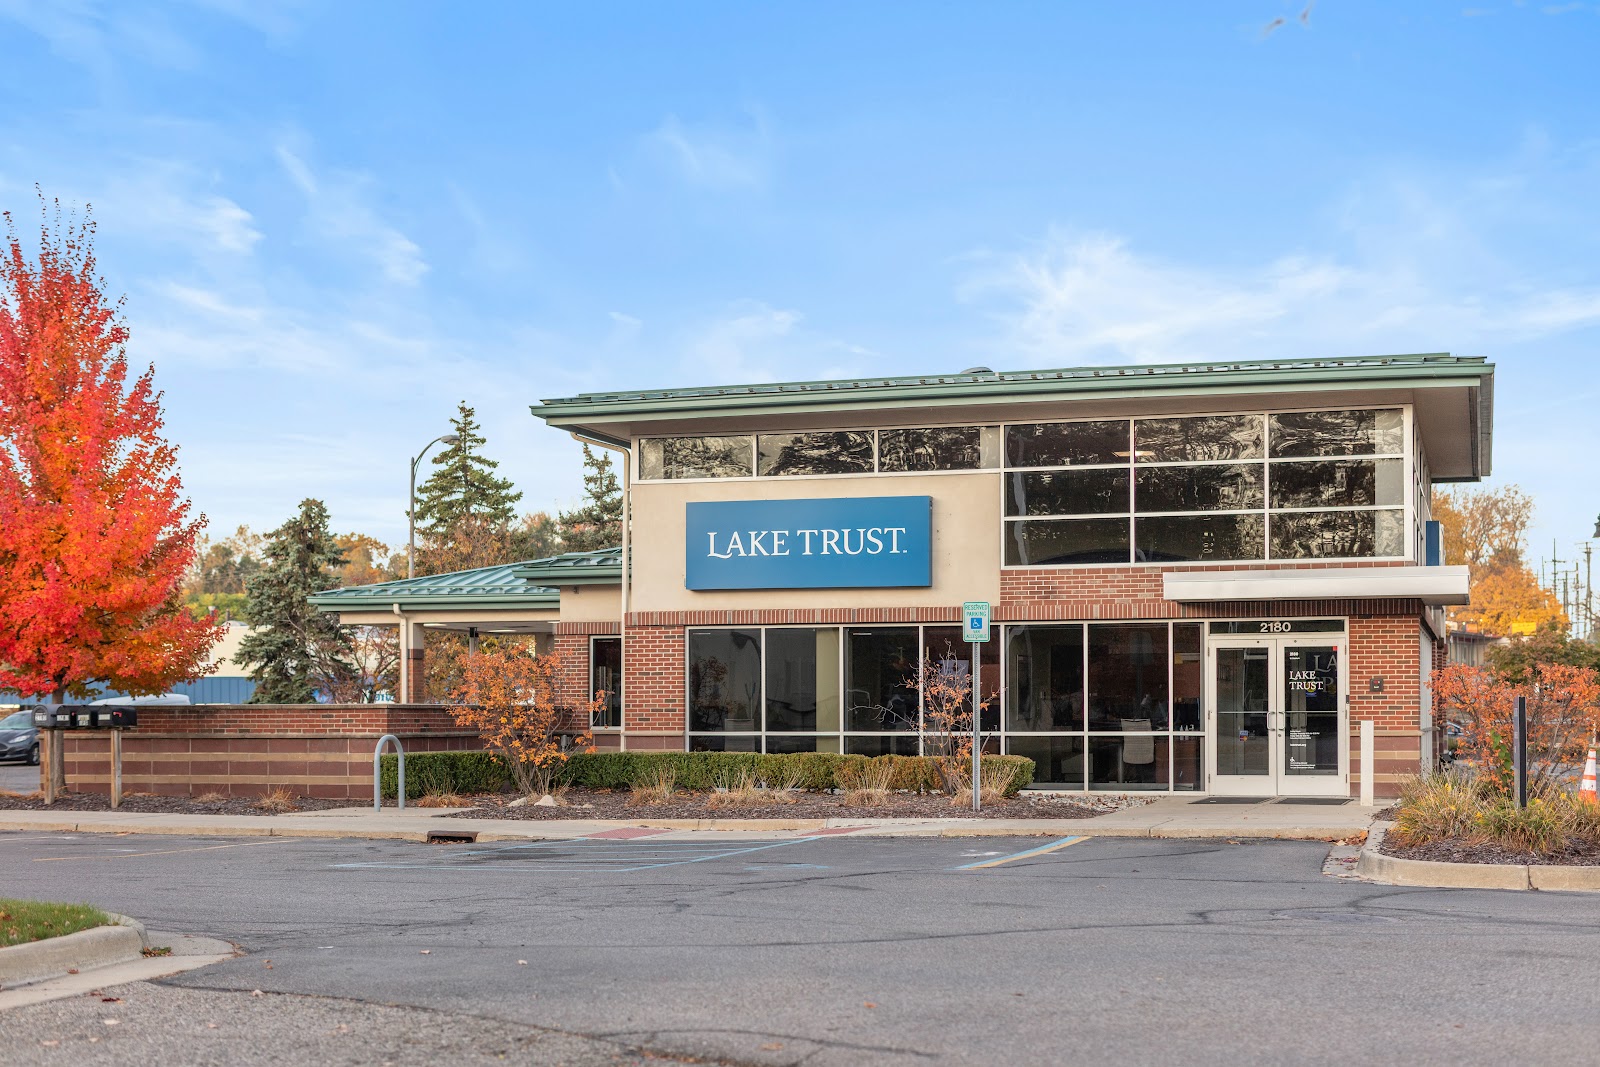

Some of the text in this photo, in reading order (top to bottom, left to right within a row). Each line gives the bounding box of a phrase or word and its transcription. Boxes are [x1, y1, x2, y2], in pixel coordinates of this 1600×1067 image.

[708, 528, 906, 558] LAKE TRUST
[1260, 622, 1291, 632] 2180
[1289, 671, 1316, 681] LAKE
[1289, 681, 1324, 690] TRUST
